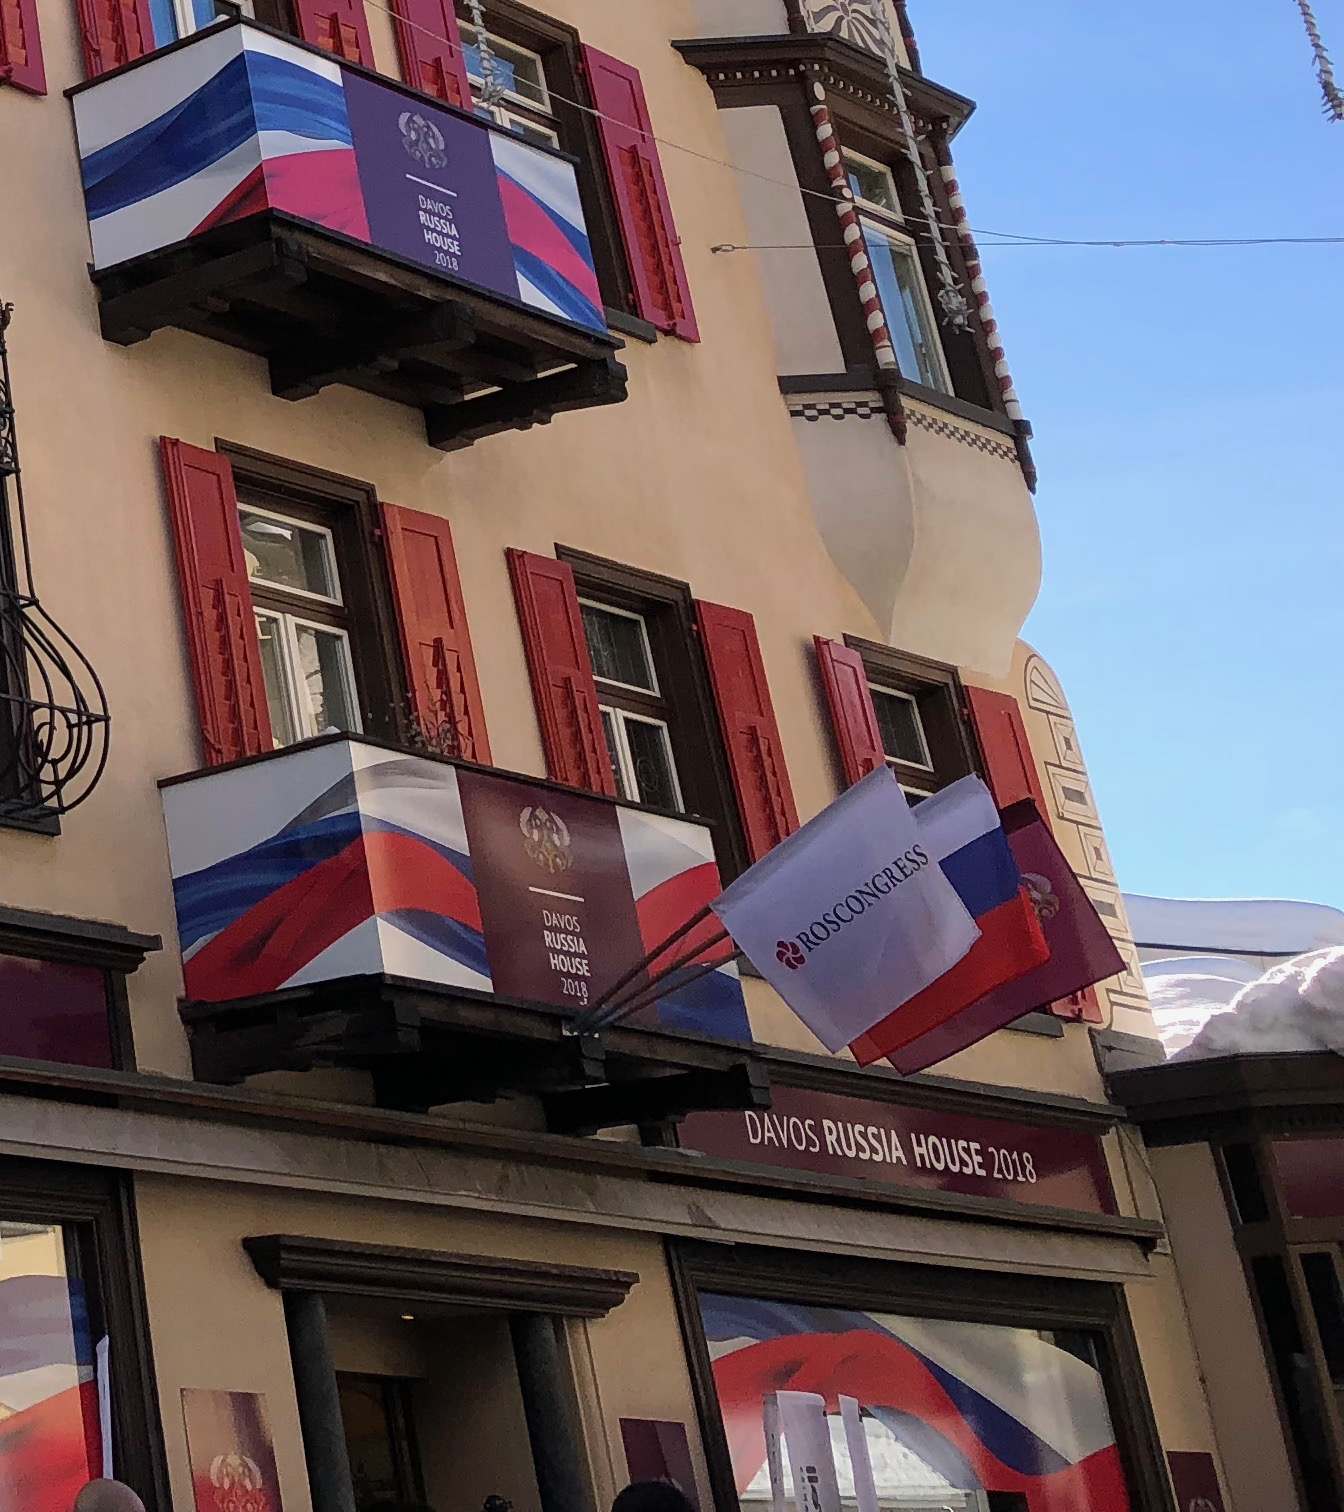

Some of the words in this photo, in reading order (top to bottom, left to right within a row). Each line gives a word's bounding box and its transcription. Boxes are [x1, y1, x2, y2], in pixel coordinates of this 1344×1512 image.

[418, 194, 453, 219] DAVOS
[418, 210, 459, 238] RUSSIA
[423, 229, 461, 255] HOUSE
[434, 251, 459, 271] 2018
[797, 843, 930, 953] ROSCONGRESS
[542, 909, 581, 933] DAVOS
[543, 930, 588, 955] RUSSIA
[549, 952, 591, 977] HOUSE
[560, 977, 589, 998] 2018
[744, 1110, 820, 1153] DAVOS
[822, 1118, 907, 1166] RUSSIA
[910, 1132, 987, 1177] HOUSE
[987, 1146, 1037, 1184] 2018
